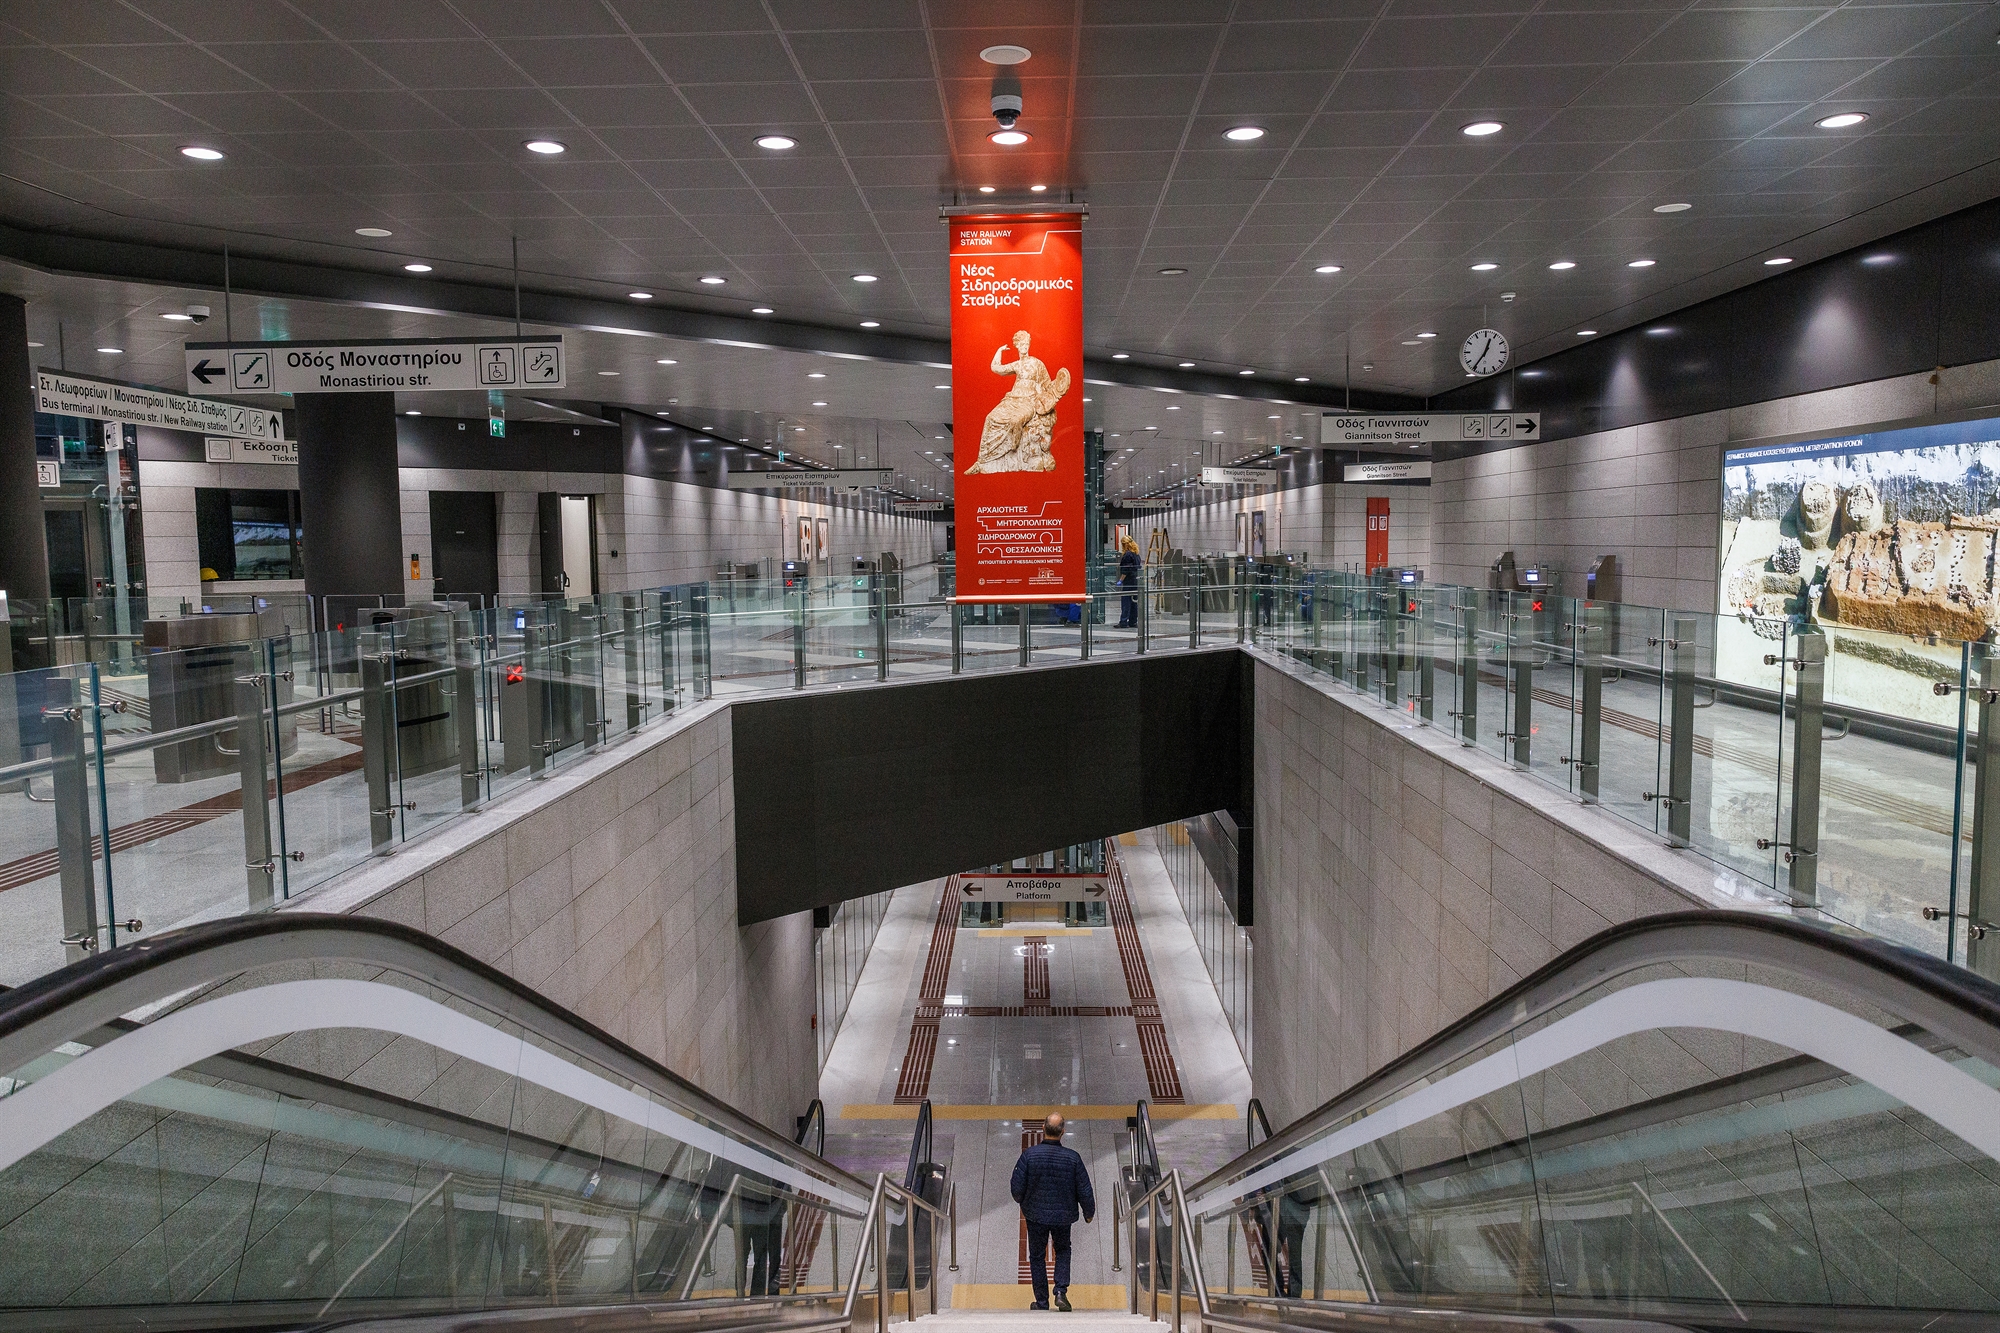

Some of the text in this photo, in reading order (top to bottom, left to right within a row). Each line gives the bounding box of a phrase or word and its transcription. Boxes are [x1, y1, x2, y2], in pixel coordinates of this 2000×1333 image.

[960, 264, 994, 277] Νέος
[961, 277, 1073, 293] Σιδηροδρομικός
[961, 293, 1020, 308] Σταθμός
[286, 350, 462, 370] Οδός Μοναστηρίου
[320, 374, 431, 388] Monastiriou str.
[40, 377, 53, 391] Στ.
[55, 380, 108, 399] Λεωφορείων
[109, 388, 112, 400] /
[114, 388, 164, 409] Μοναστηρίου
[169, 397, 186, 414] Νέος
[187, 400, 200, 413] Σιδ.
[201, 403, 227, 419] Σταθμός
[42, 397, 59, 410] Bus
[61, 400, 95, 414] terminal
[102, 405, 146, 421] Monastiriou
[148, 414, 159, 423] str.
[164, 415, 180, 425] New
[181, 417, 206, 430] Railway
[207, 421, 228, 432] station
[1336, 418, 1430, 430] Οδός Γιαννιτσών
[1344, 432, 1392, 440] Giannitson
[241, 442, 288, 453] Έκδοση
[1006, 880, 1061, 890] Αποβάθρα
